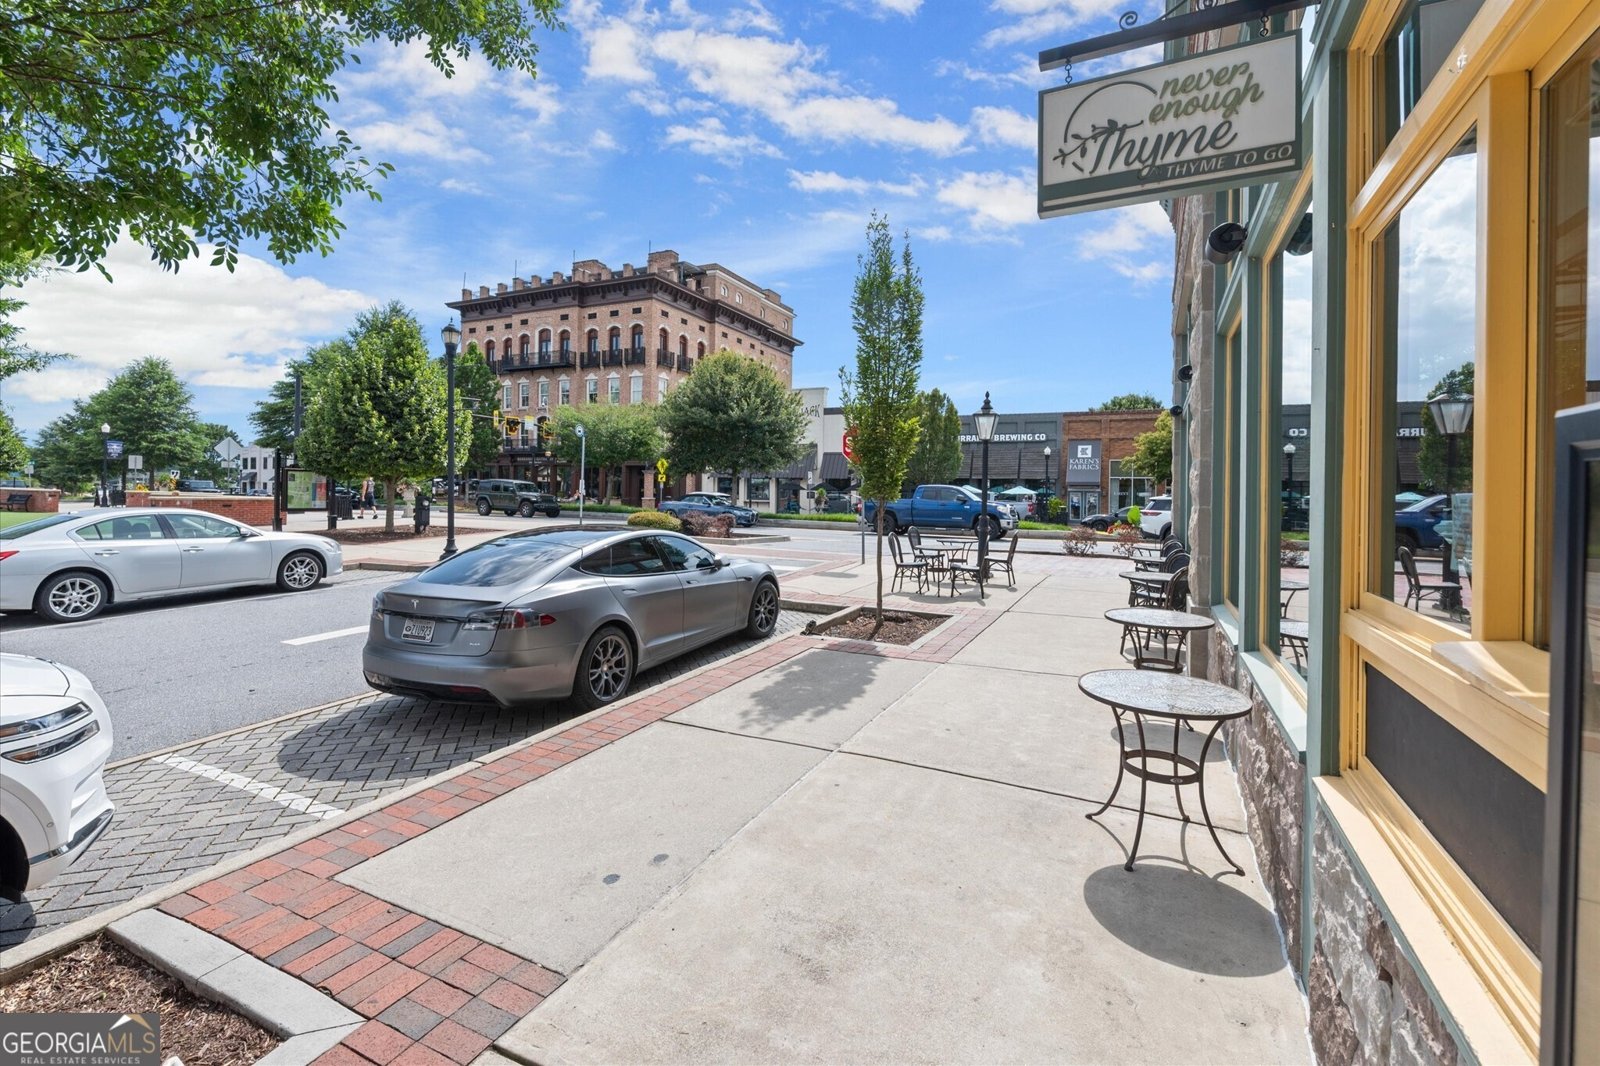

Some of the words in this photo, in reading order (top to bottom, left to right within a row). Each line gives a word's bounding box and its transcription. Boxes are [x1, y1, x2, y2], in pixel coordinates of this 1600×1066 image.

[1149, 72, 1264, 121] enough
[1159, 61, 1250, 99] never
[1088, 119, 1238, 181] Thyme
[1166, 155, 1226, 179] THYME
[1234, 150, 1257, 166] TO
[1264, 144, 1293, 162] GO
[994, 434, 1033, 442] BREWING
[1034, 433, 1046, 441] CO
